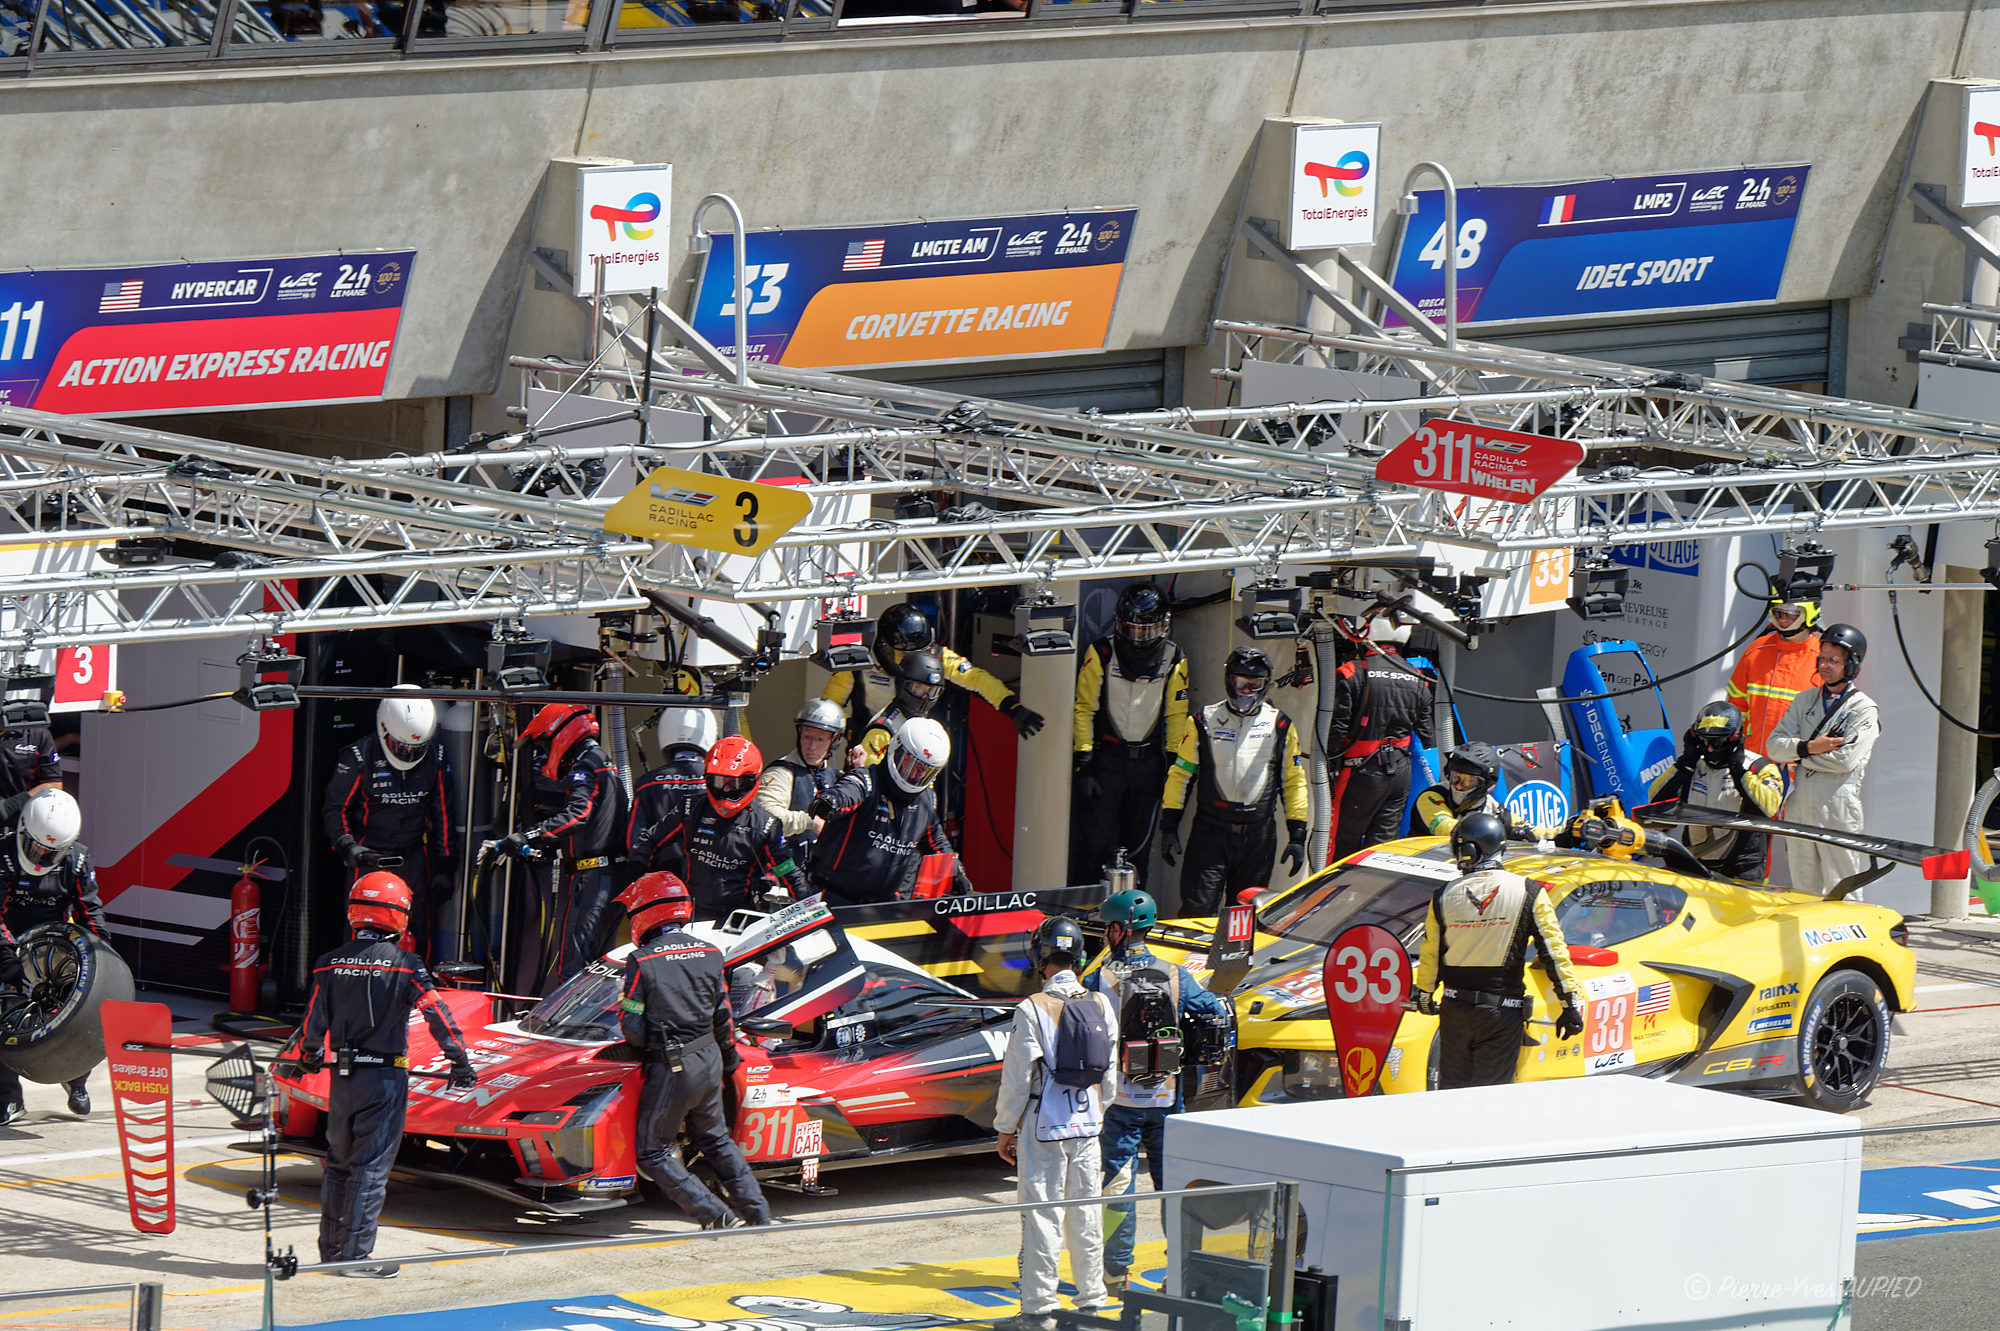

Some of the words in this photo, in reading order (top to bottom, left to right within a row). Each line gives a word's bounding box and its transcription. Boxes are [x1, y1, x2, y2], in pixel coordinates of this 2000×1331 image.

[1691, 185, 1729, 201] WEC
[1738, 177, 1772, 202] 24h
[1634, 192, 1672, 211] LMP2
[1301, 206, 1368, 221] TotalEnergies
[1007, 231, 1048, 246] WEC
[1056, 222, 1092, 248] 24h
[1418, 217, 1487, 270] 48
[911, 239, 956, 259] LMGTE
[958, 236, 988, 253] AM
[279, 271, 322, 288] WEC
[332, 263, 372, 290] 24h
[1575, 263, 1634, 290] IDEC
[1635, 256, 1714, 286] SPORT
[171, 278, 257, 300] HYPERCAR
[846, 307, 977, 341] CORVETTE
[978, 300, 1073, 332] RACING
[57, 356, 166, 388] ACTION
[165, 346, 290, 382] EXPRESS
[288, 339, 392, 373] RACING
[1413, 427, 1472, 484] 311
[1474, 451, 1528, 467] CADILLAC
[1474, 460, 1514, 472] RACING
[1470, 467, 1537, 495] WHELEN
[649, 504, 715, 523] CADILLAC
[649, 513, 698, 529] RACING
[733, 491, 759, 547] 3
[1533, 549, 1569, 588] 33
[1624, 602, 1668, 619] HEVREUSE
[73, 646, 93, 685] 3
[779, 903, 801, 919] SIMS
[934, 891, 1037, 915] CADILLAC
[775, 916, 811, 937] DERANI
[1228, 909, 1251, 938] HY
[1804, 925, 1853, 947] Mobil
[653, 942, 707, 953] CADILLAC
[665, 951, 706, 961] RACING
[330, 957, 393, 967] CADILLAC
[333, 968, 382, 977] RACING
[1334, 946, 1401, 1004] 33
[1592, 996, 1628, 1052] 33
[112, 1063, 148, 1077] Brakes
[1594, 1053, 1625, 1069] WEC
[1703, 1053, 1786, 1075] C8.R
[149, 1066, 168, 1078] OFF
[113, 1080, 141, 1092] BACK
[142, 1082, 169, 1094] PUSH
[1062, 1088, 1090, 1114] 19
[738, 1109, 794, 1157] 311
[797, 1121, 821, 1137] HYPER
[794, 1134, 821, 1156] CAR
[803, 1164, 818, 1180] 311
